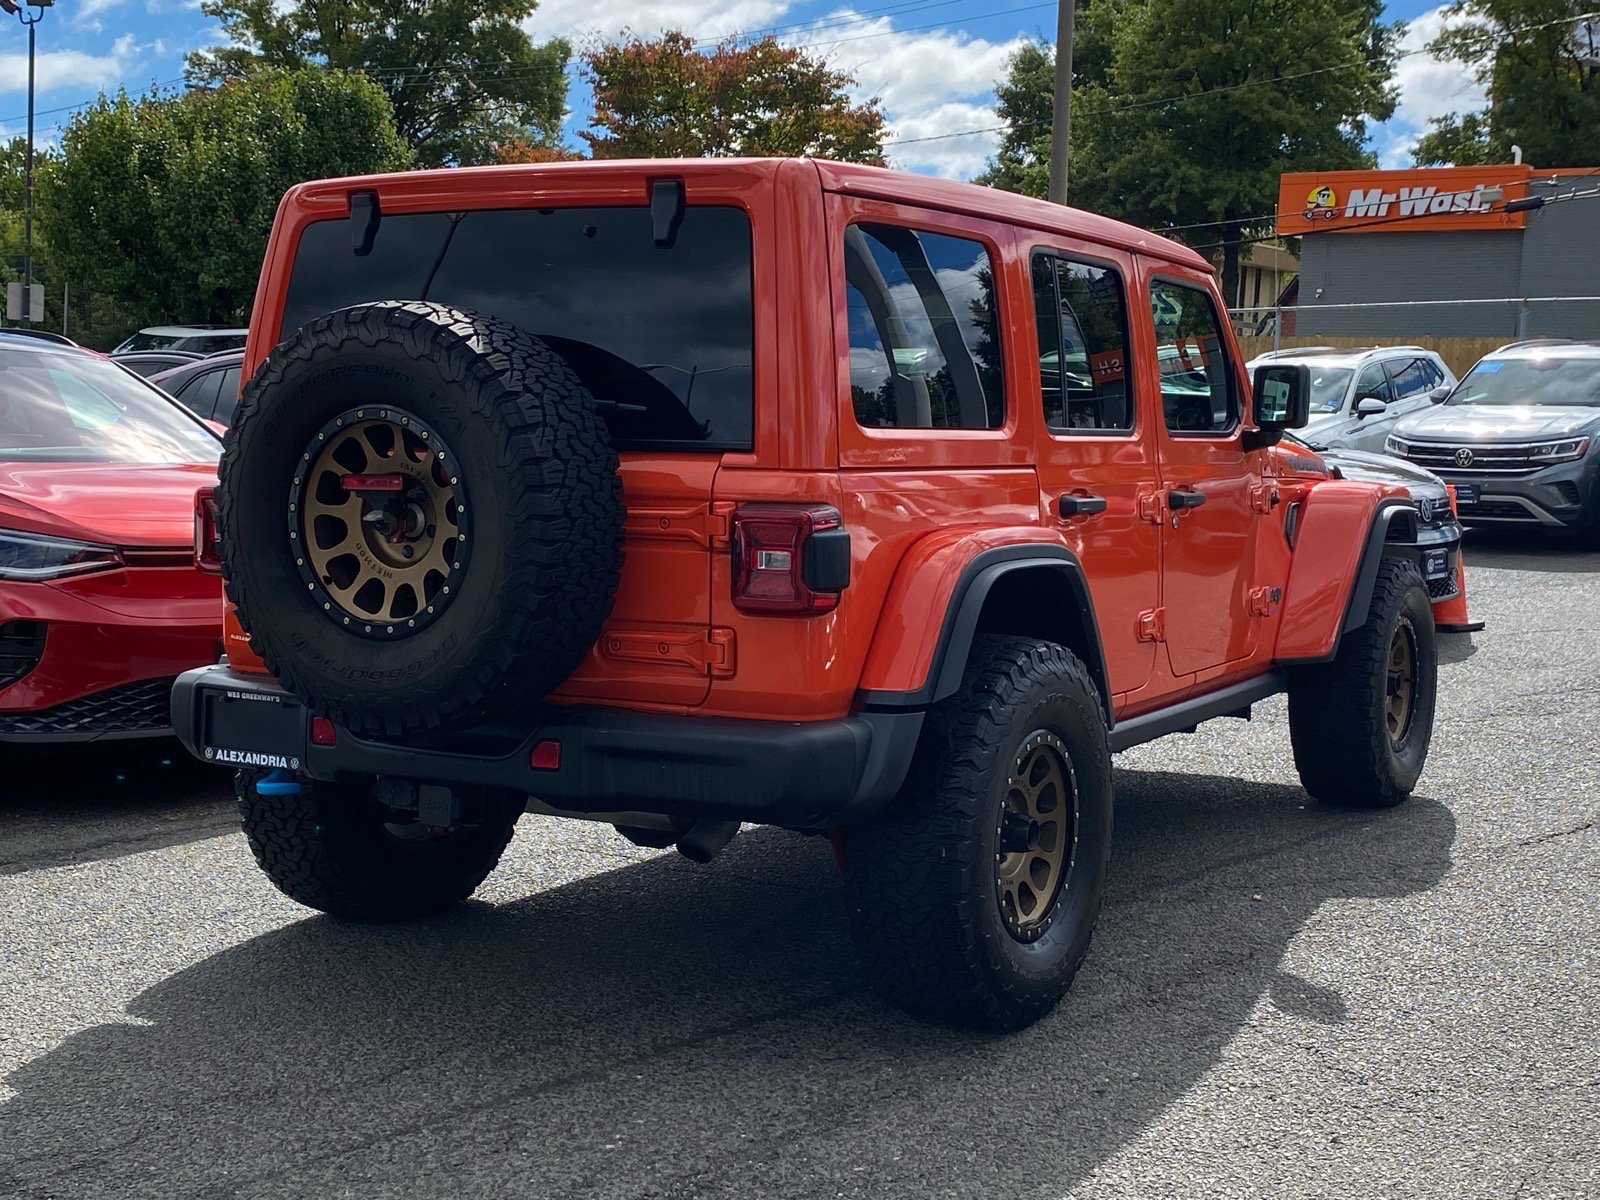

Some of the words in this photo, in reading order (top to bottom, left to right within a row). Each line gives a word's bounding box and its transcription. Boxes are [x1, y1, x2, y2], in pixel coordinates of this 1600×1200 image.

[1344, 188, 1396, 218] Mr
[226, 690, 240, 699] WES
[241, 692, 280, 703] GREENWAY'S
[215, 749, 288, 769] ALEXANDRIA
